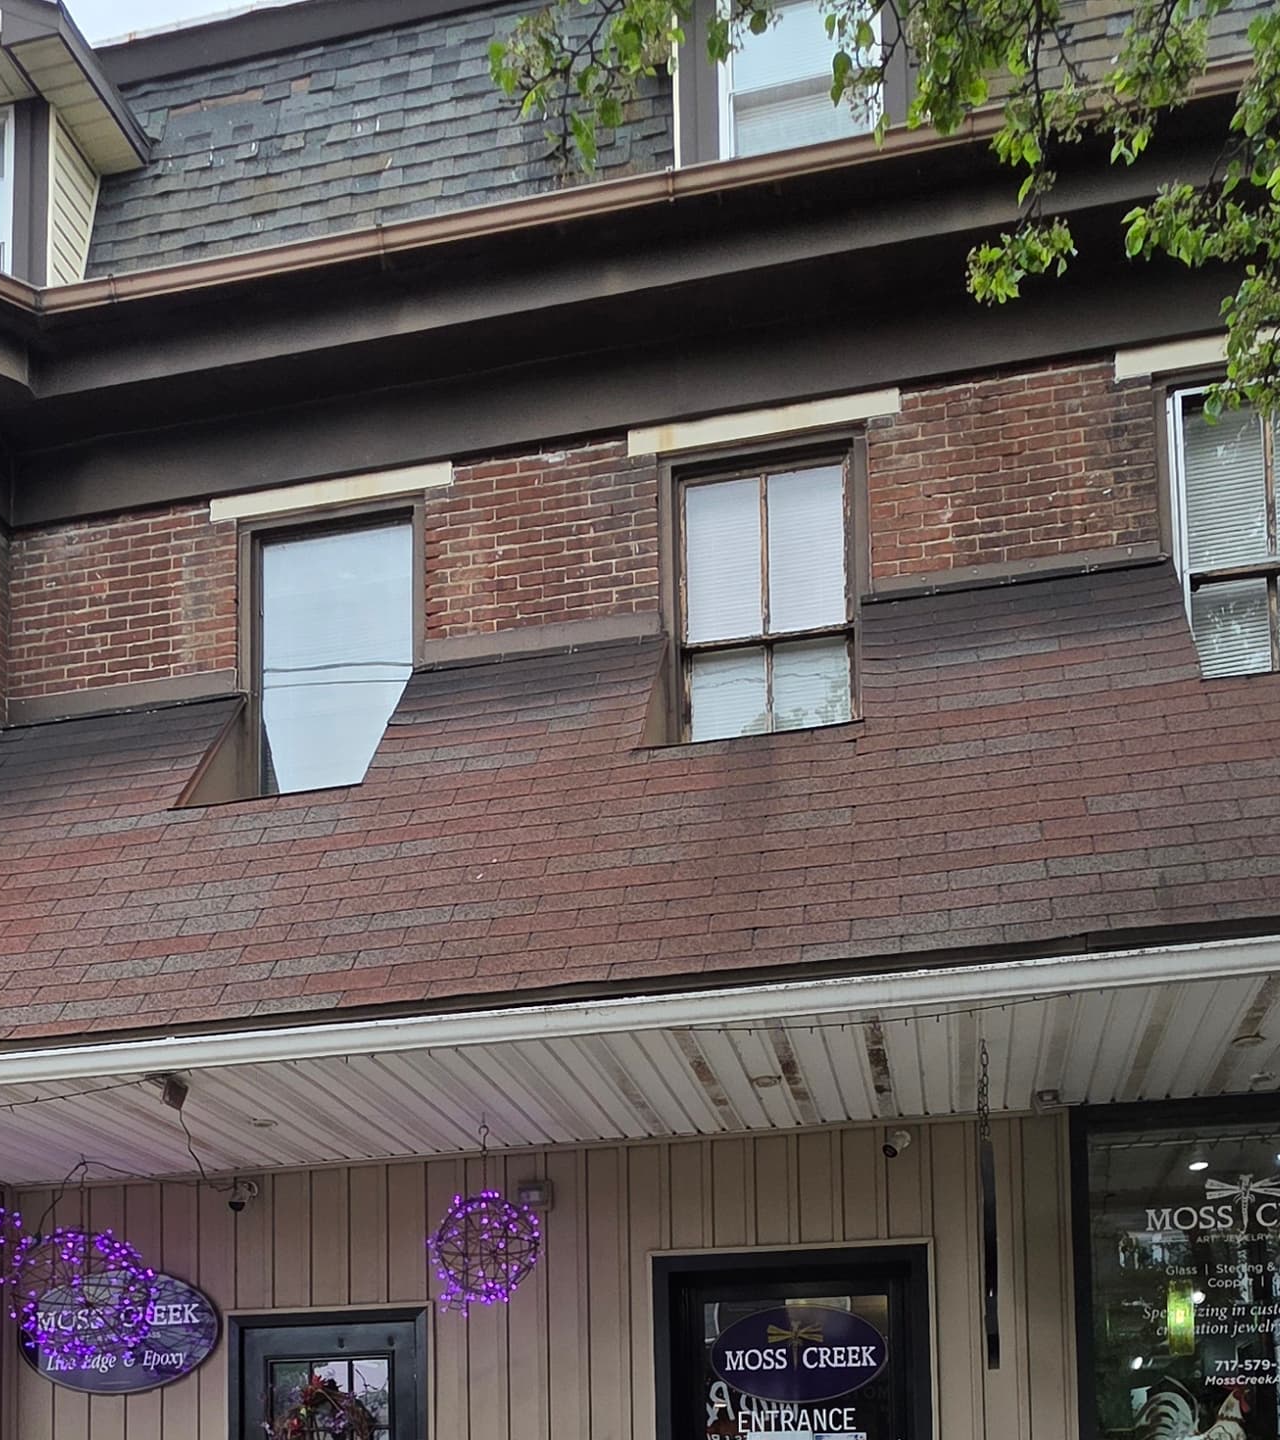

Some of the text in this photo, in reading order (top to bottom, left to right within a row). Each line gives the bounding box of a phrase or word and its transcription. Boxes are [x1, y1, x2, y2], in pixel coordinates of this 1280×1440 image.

[1145, 1205, 1234, 1231] MOSS
[1196, 1235, 1215, 1244] ART
[1166, 1265, 1198, 1276] Glass
[1216, 1262, 1263, 1274] Steng
[1266, 1261, 1276, 1271] &
[1207, 1277, 1254, 1289] Coppr
[1142, 1303, 1228, 1323] Speizing
[1231, 1303, 1246, 1316] in
[1156, 1321, 1229, 1337] crtion
[143, 1350, 187, 1370] Epoxy
[725, 1346, 877, 1371] MOSS CREEK
[738, 1408, 856, 1433] ENTRANCE
